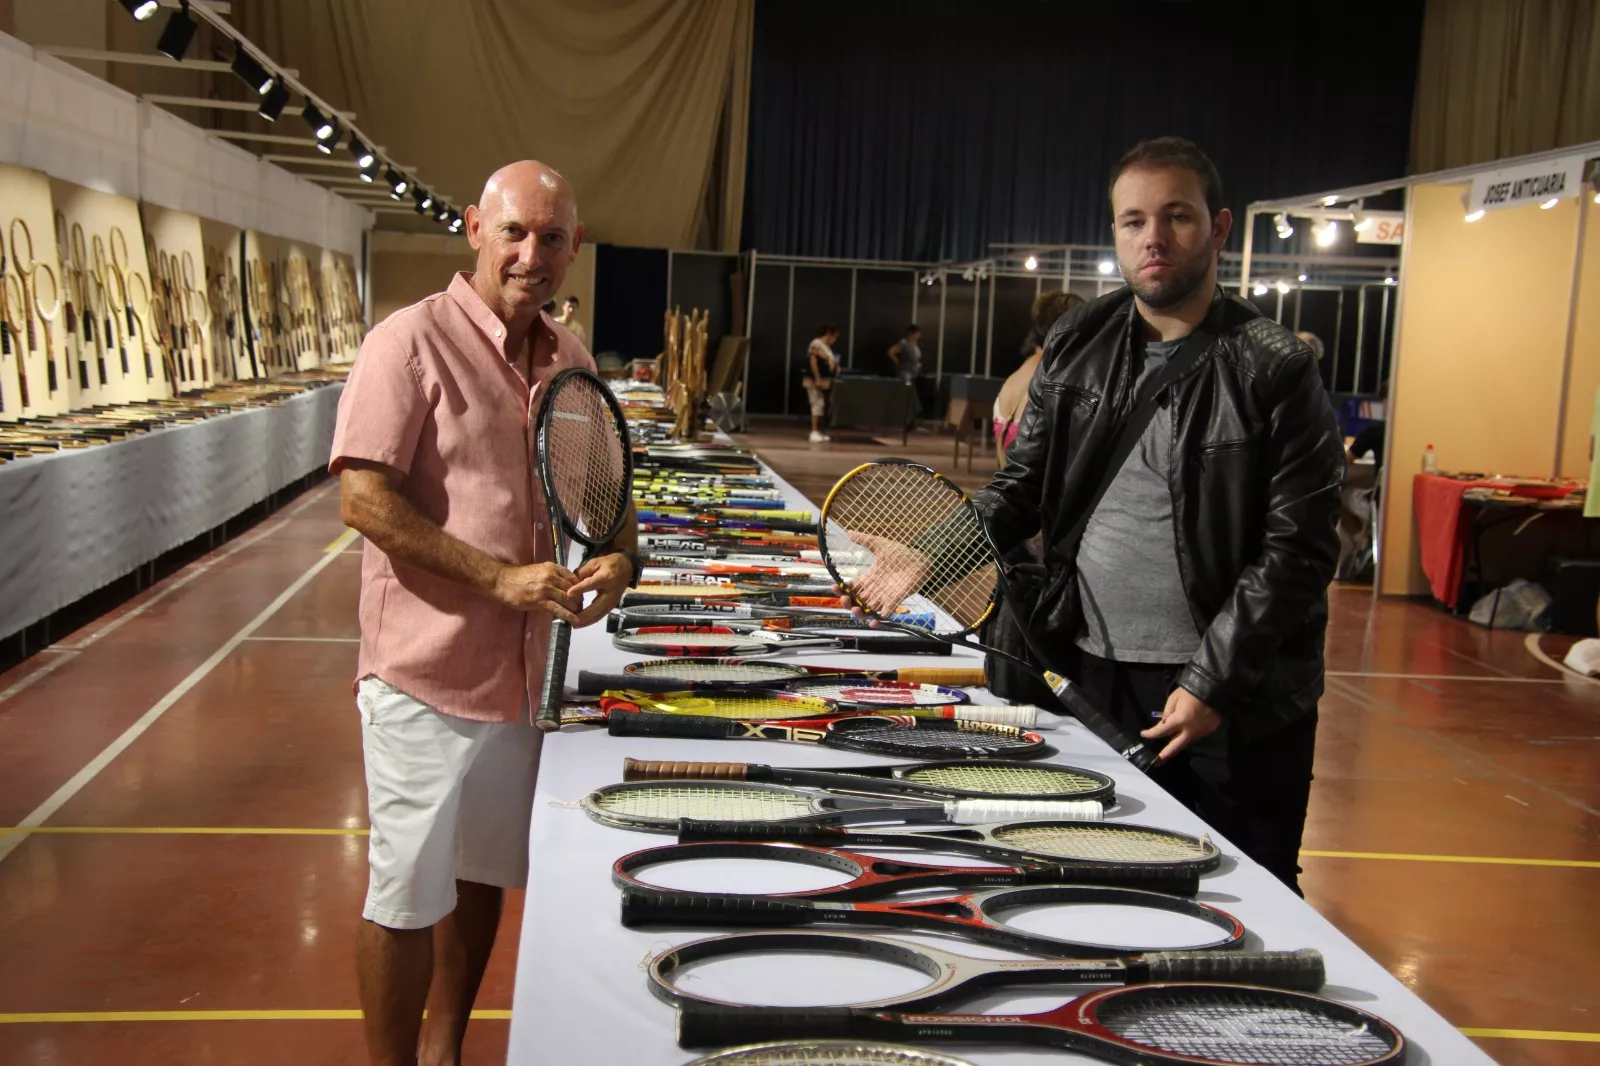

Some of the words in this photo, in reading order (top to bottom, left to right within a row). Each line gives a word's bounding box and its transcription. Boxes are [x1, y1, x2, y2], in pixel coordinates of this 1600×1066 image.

[1483, 181, 1512, 204] JOSEF
[675, 573, 732, 586] HEAD
[668, 603, 737, 613] HEAD
[908, 1015, 1029, 1024] ROSSIGNOL
